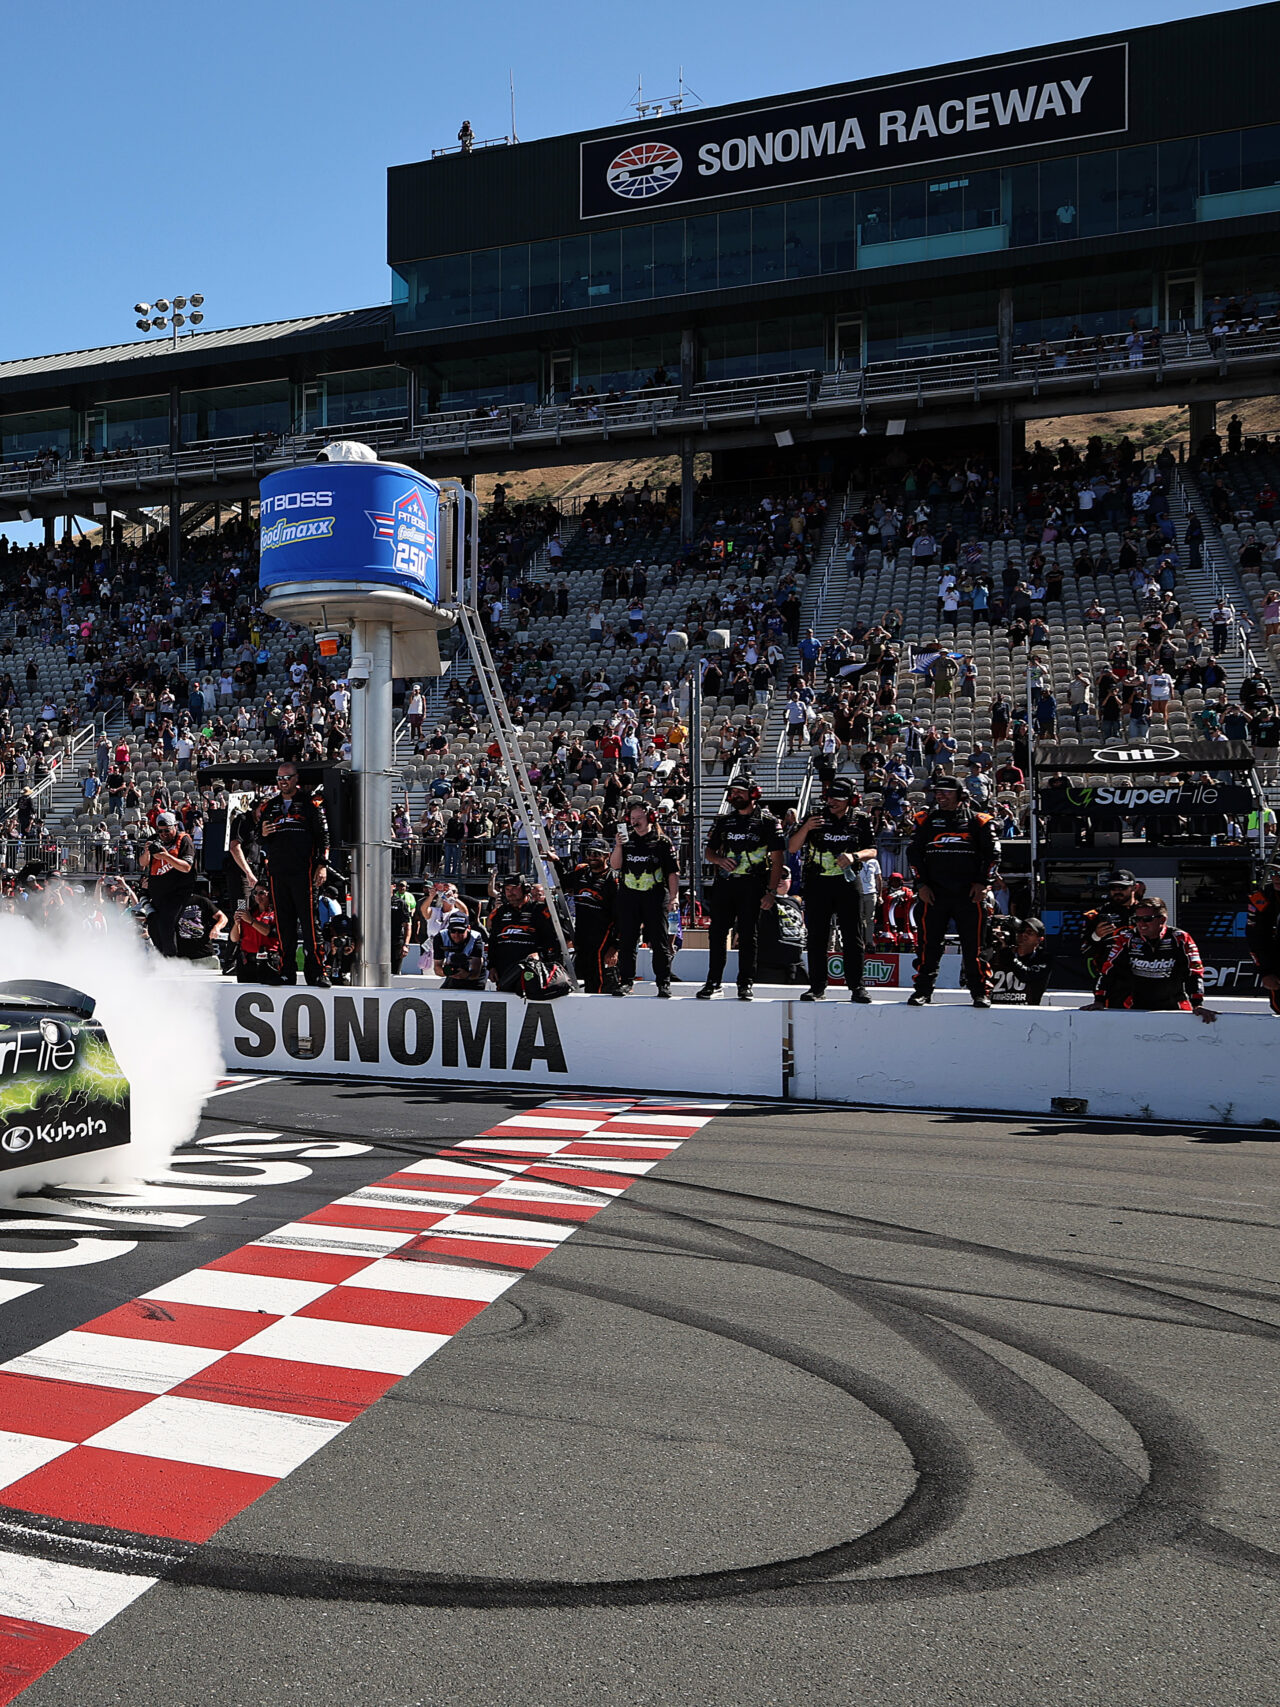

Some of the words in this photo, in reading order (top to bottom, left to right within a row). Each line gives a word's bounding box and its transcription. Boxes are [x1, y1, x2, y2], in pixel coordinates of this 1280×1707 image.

[697, 117, 866, 177] SONOMA
[879, 75, 1094, 147] RACEWAY
[274, 491, 333, 511] BOSS
[396, 542, 426, 579] 250
[1095, 786, 1219, 808] SuperFile
[828, 958, 889, 980] Oeilly
[1130, 957, 1176, 968] Hendrick
[234, 991, 569, 1074] SONOMA
[36, 1117, 107, 1146] Kubota
